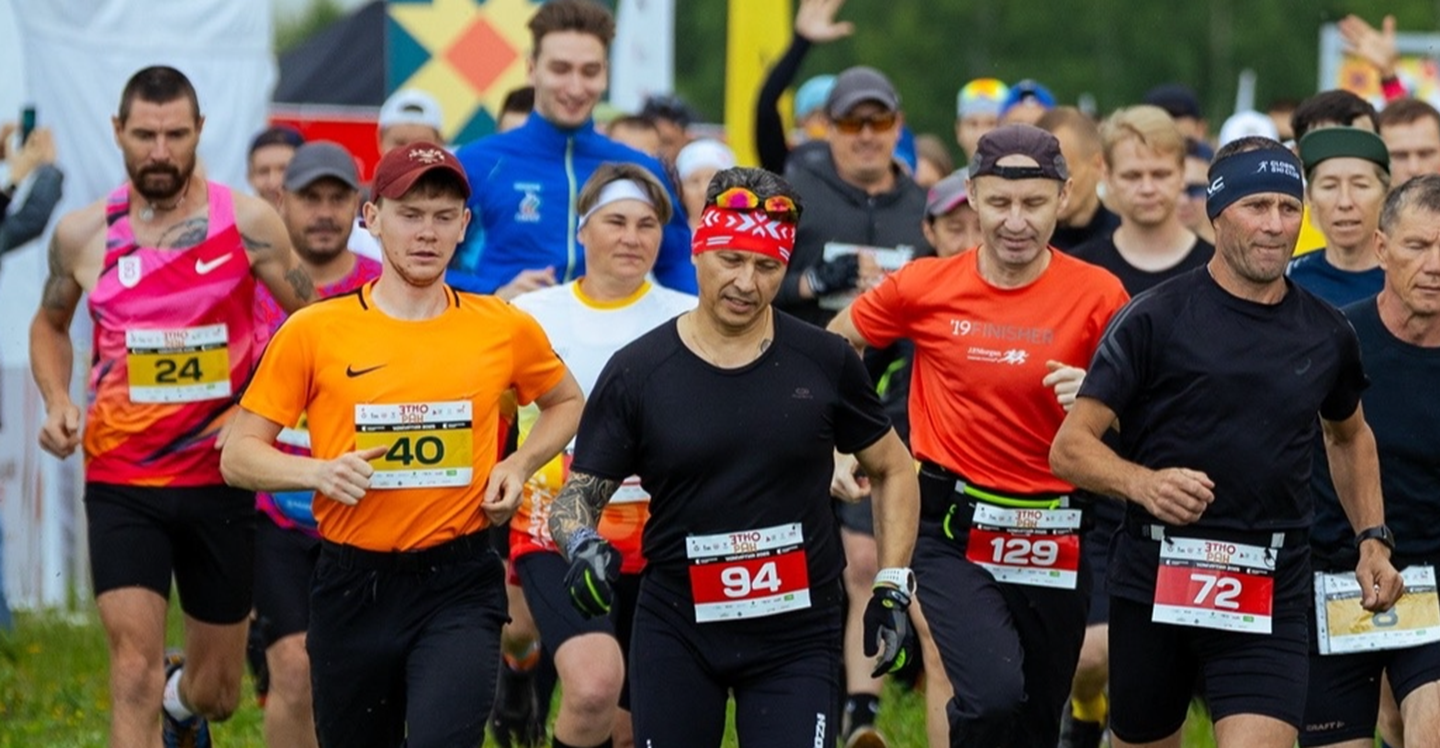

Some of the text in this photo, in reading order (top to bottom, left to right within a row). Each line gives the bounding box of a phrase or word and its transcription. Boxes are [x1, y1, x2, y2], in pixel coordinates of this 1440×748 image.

[155, 357, 203, 383] 24
[385, 435, 445, 466] 40
[990, 537, 1059, 566] 129
[720, 561, 782, 598] 94
[1190, 573, 1242, 610] 72
